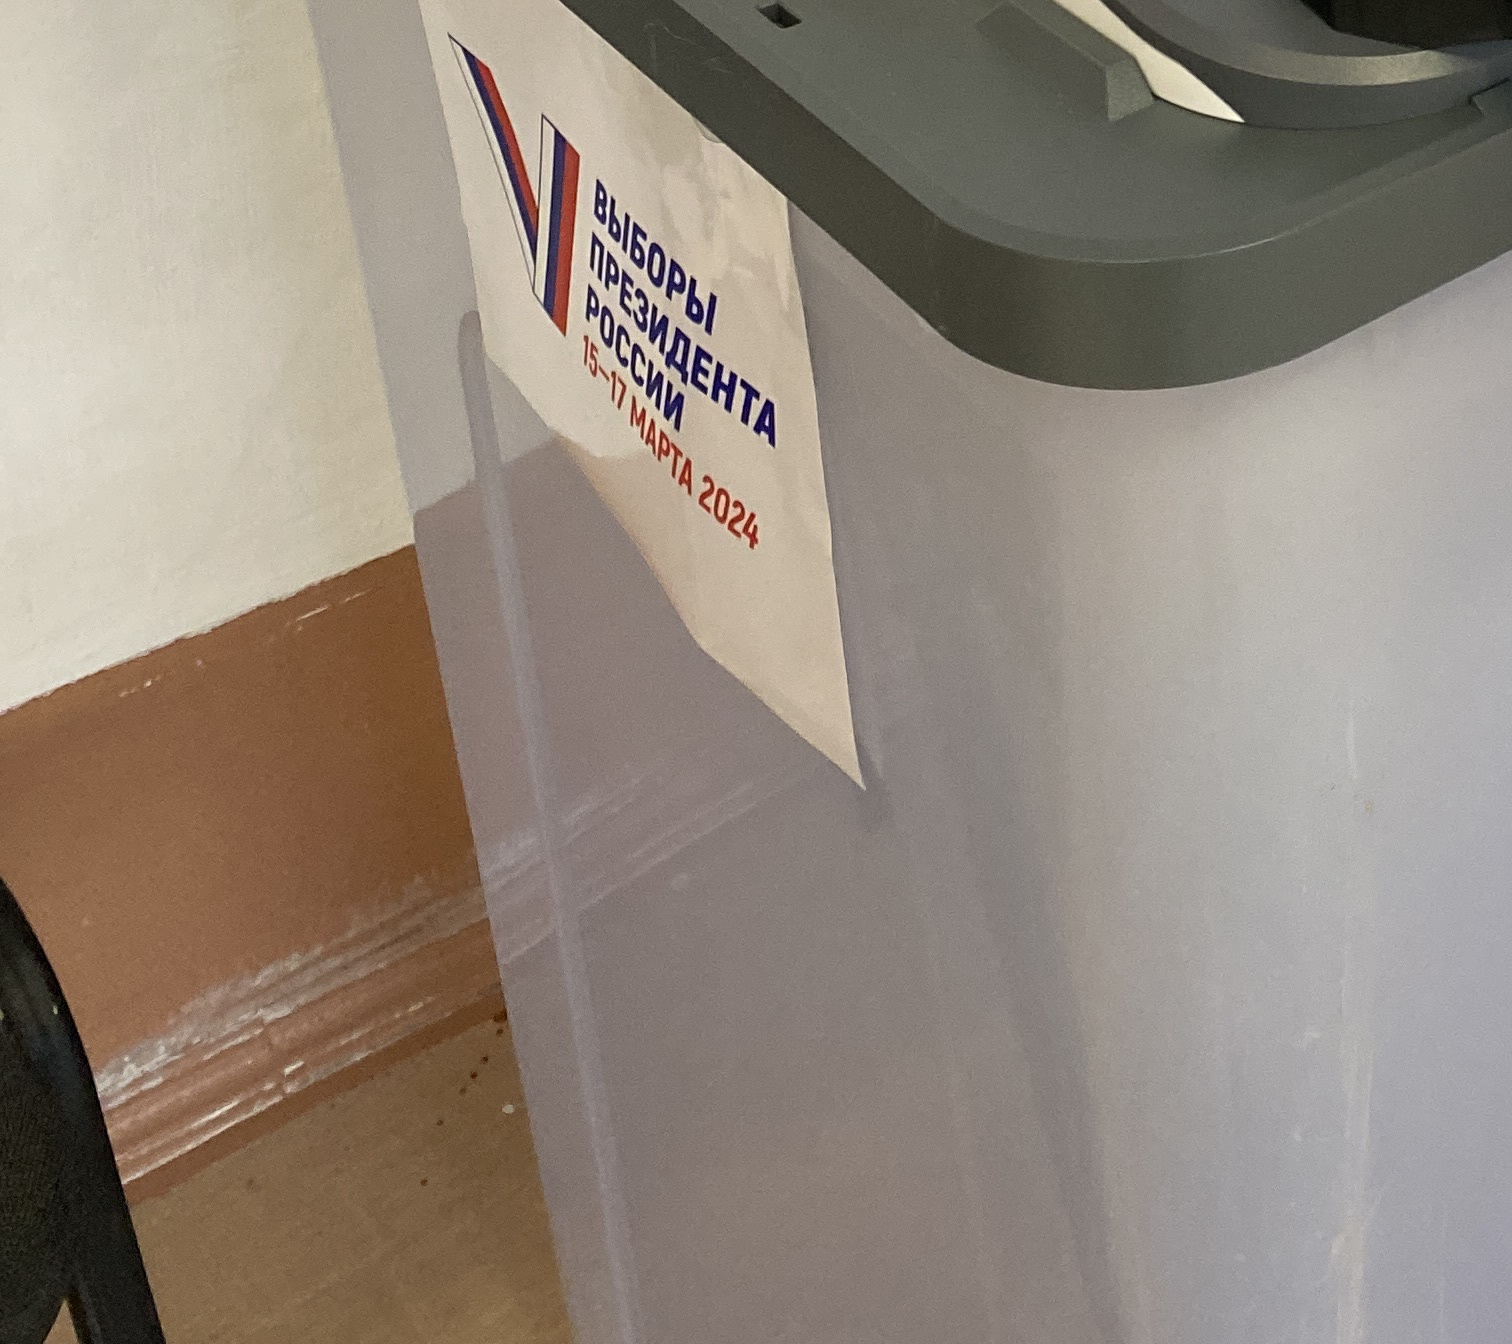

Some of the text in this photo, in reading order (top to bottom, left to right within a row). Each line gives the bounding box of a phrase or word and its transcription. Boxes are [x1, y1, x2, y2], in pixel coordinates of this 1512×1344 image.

[592, 177, 718, 337] ВЫБОРЫ
[585, 284, 685, 433] РОССИИ
[589, 231, 778, 449] ПРЕЗИДЕНТА
[629, 403, 693, 496] МАРТА
[699, 473, 761, 551] 2024
